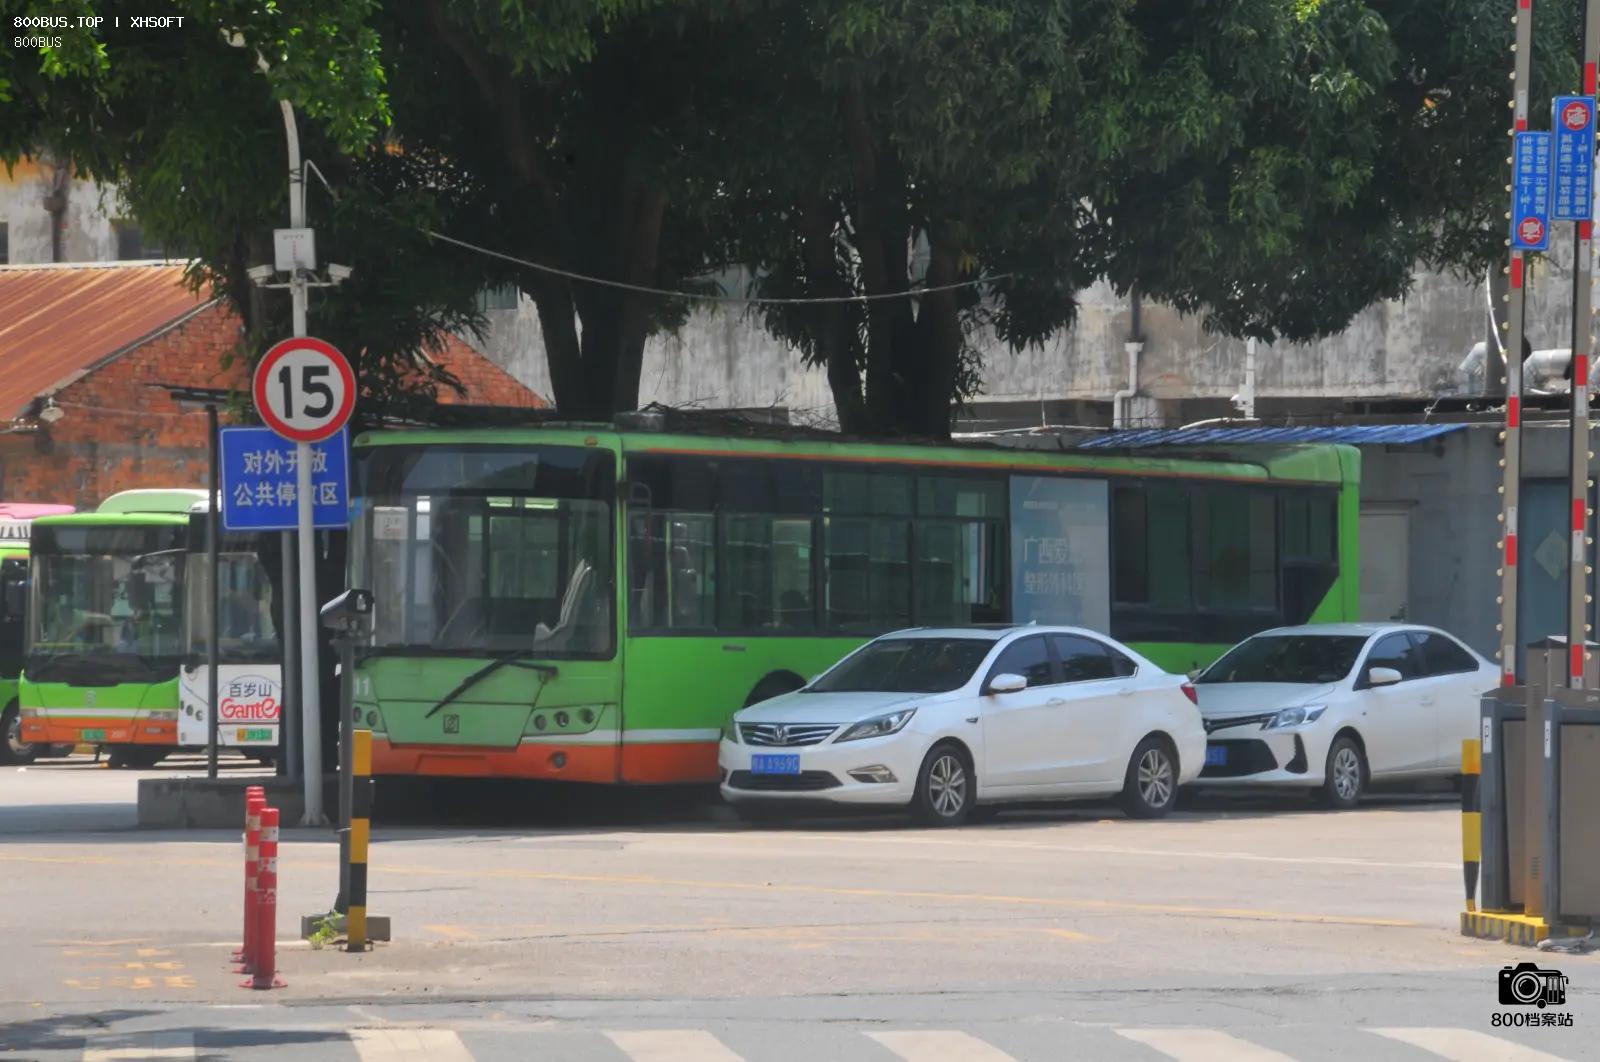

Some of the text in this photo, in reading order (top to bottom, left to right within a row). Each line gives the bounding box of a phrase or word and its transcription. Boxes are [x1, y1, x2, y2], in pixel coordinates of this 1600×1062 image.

[1567, 107, 1586, 125] 慢
[1559, 134, 1572, 173] 减速慢行
[1574, 134, 1588, 173] 一车一杆
[1520, 176, 1533, 213] 一车一杆
[1522, 222, 1541, 240] 慢
[278, 365, 334, 419] 15
[233, 482, 339, 507] 公共停区
[230, 682, 272, 698] 百岁山
